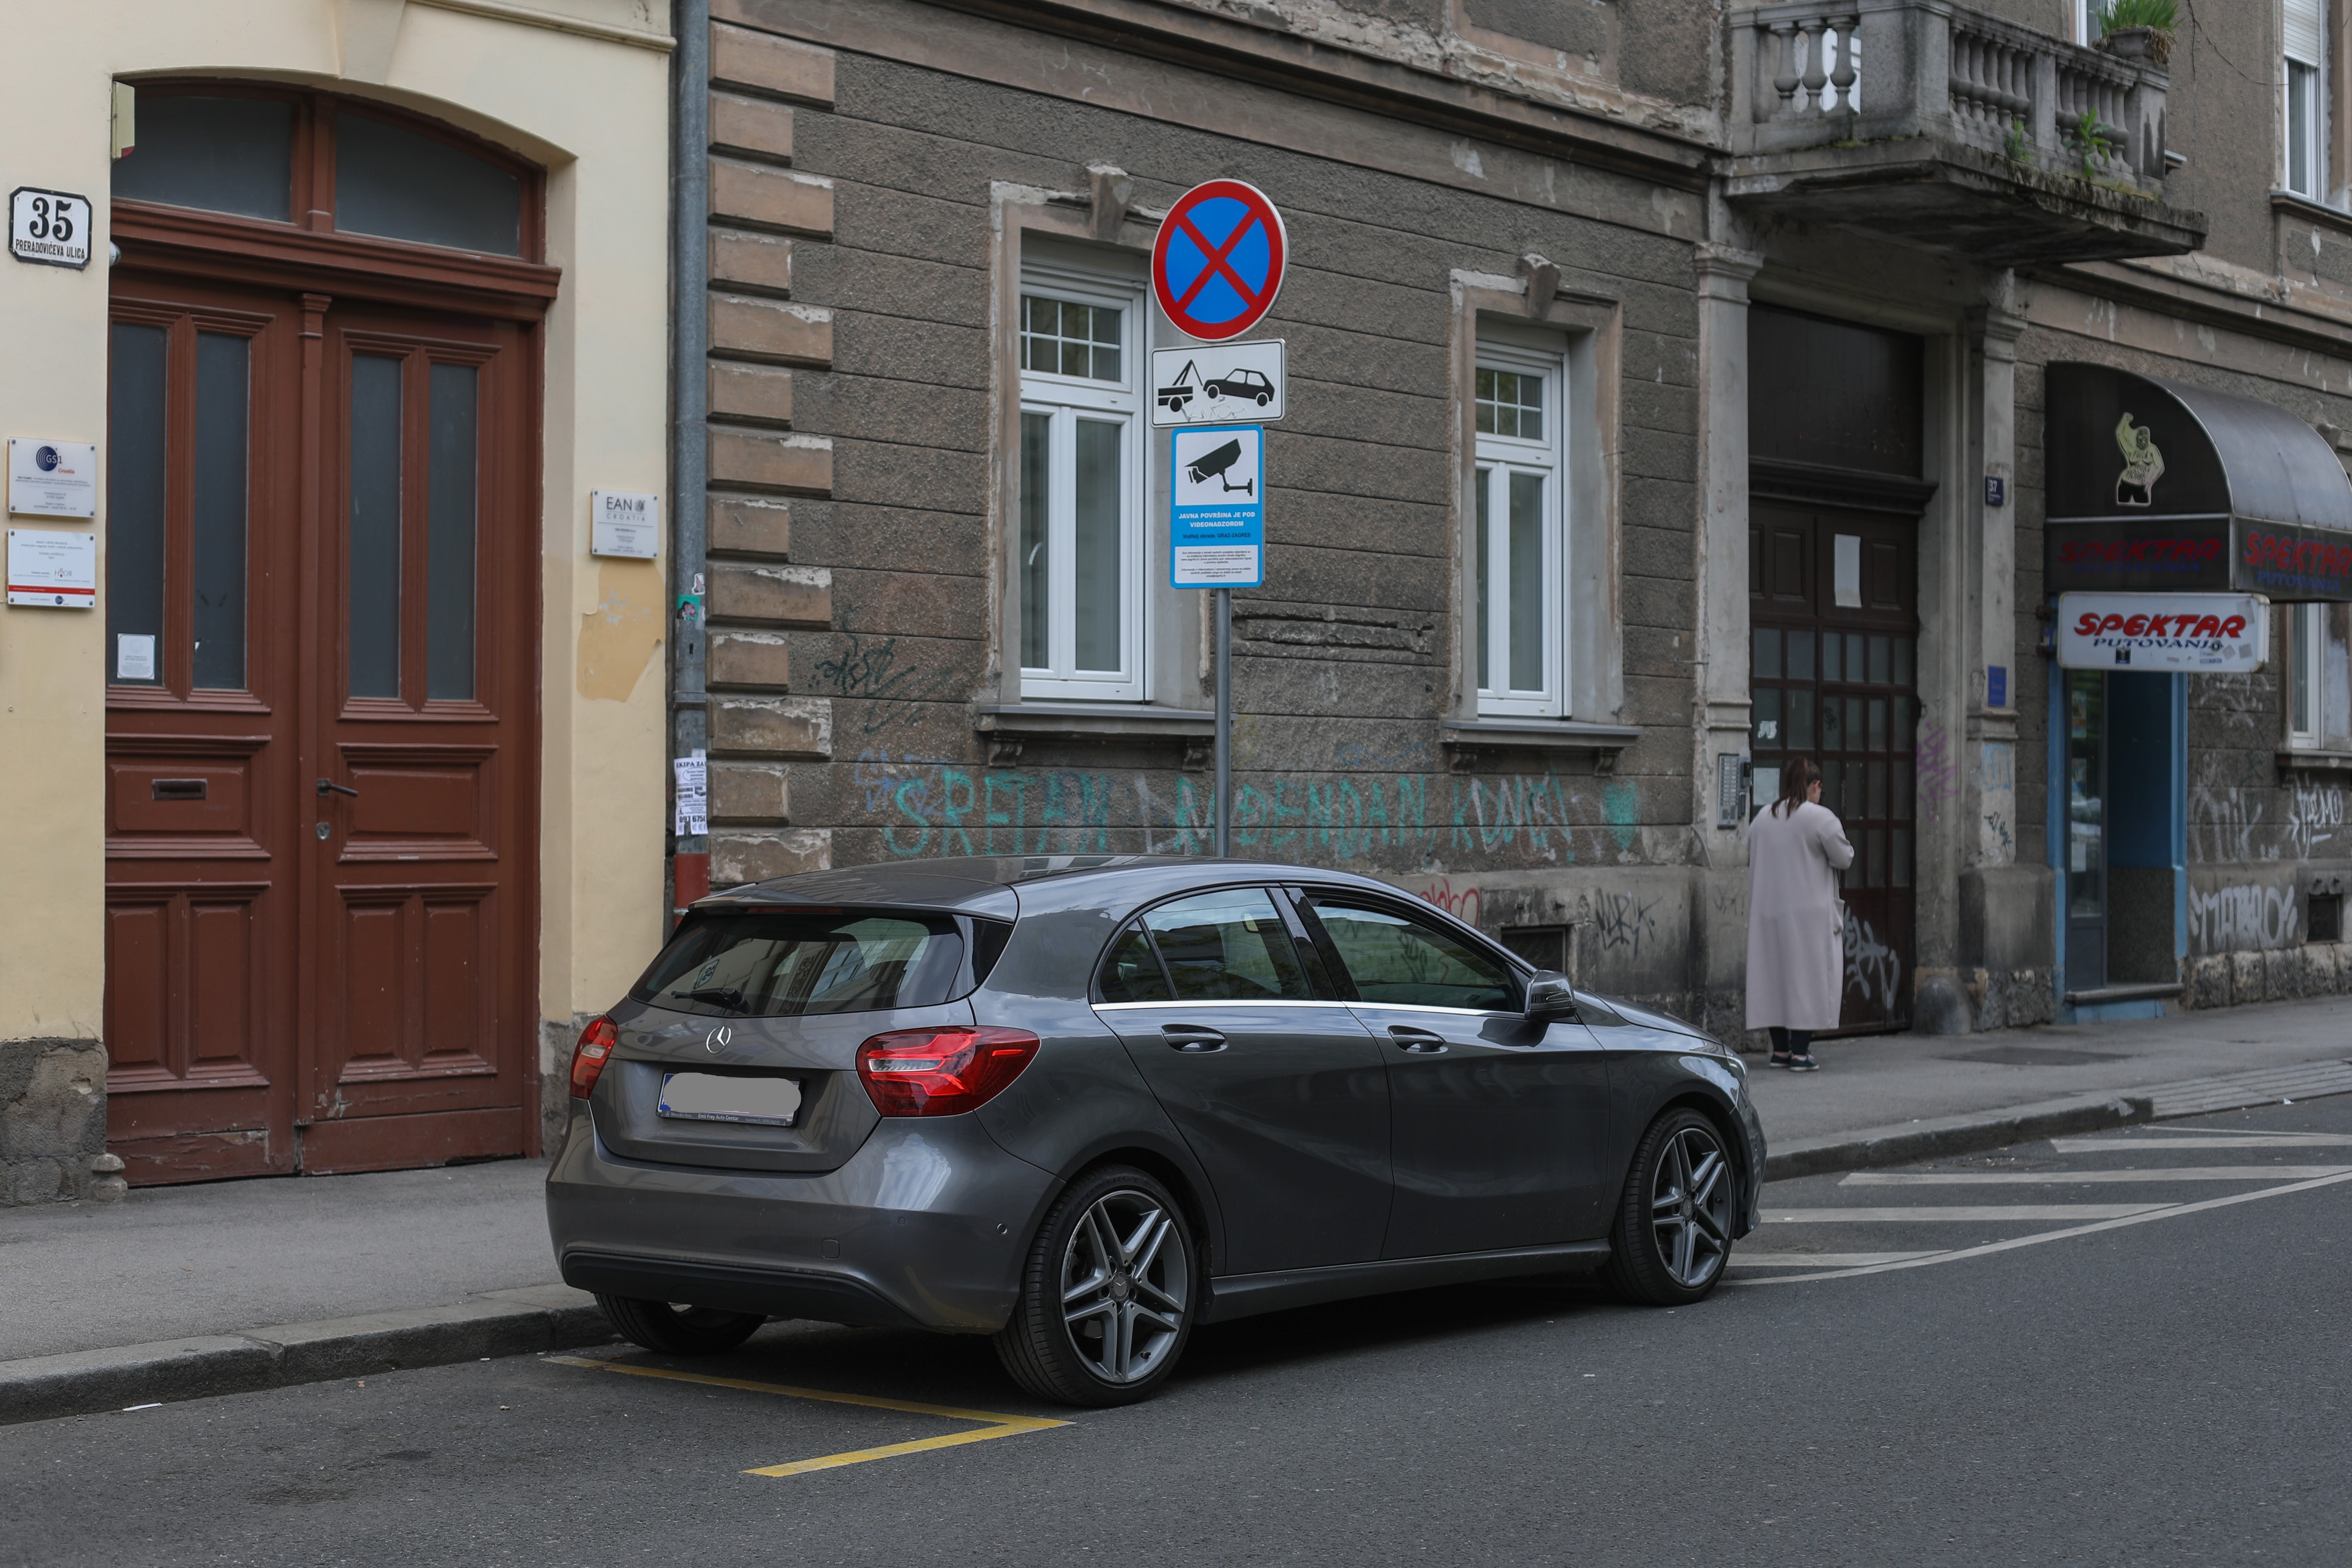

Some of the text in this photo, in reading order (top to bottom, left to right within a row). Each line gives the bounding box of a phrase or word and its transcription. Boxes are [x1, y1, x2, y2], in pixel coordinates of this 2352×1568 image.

[29, 196, 73, 242] 35
[66, 246, 85, 259] ULICA
[46, 454, 63, 464] GS1
[606, 496, 632, 511] EAN
[606, 513, 646, 522] CROATIA
[2057, 538, 2221, 563] SPEKTAR
[2244, 530, 2352, 579] SPEKTAR
[2075, 561, 2202, 574] PUTOVANJA
[2257, 571, 2341, 593] PUTOVANJA
[2074, 612, 2247, 638] SPEKTAR
[885, 769, 1108, 857] SRETAN
